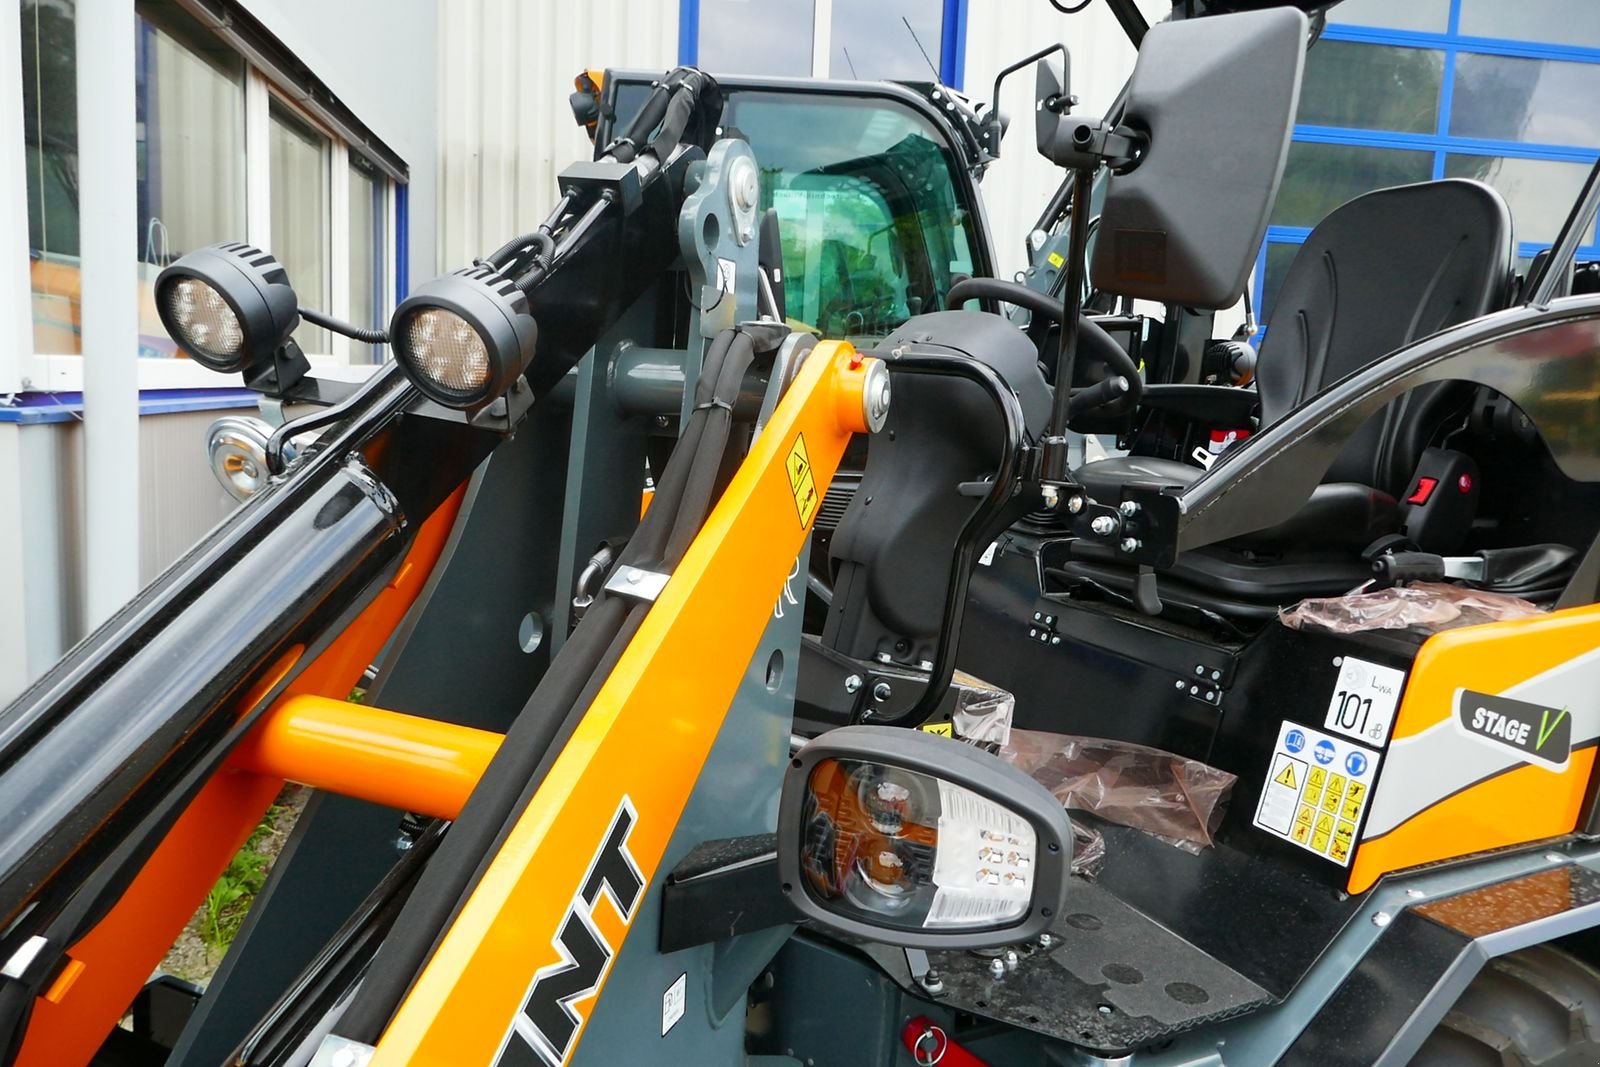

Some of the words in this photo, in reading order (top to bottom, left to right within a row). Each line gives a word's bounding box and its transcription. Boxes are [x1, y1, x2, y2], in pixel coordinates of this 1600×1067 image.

[1334, 690, 1373, 735] 101
[1368, 723, 1383, 740] dB
[1472, 707, 1532, 745] STAGE
[1535, 706, 1569, 751] V
